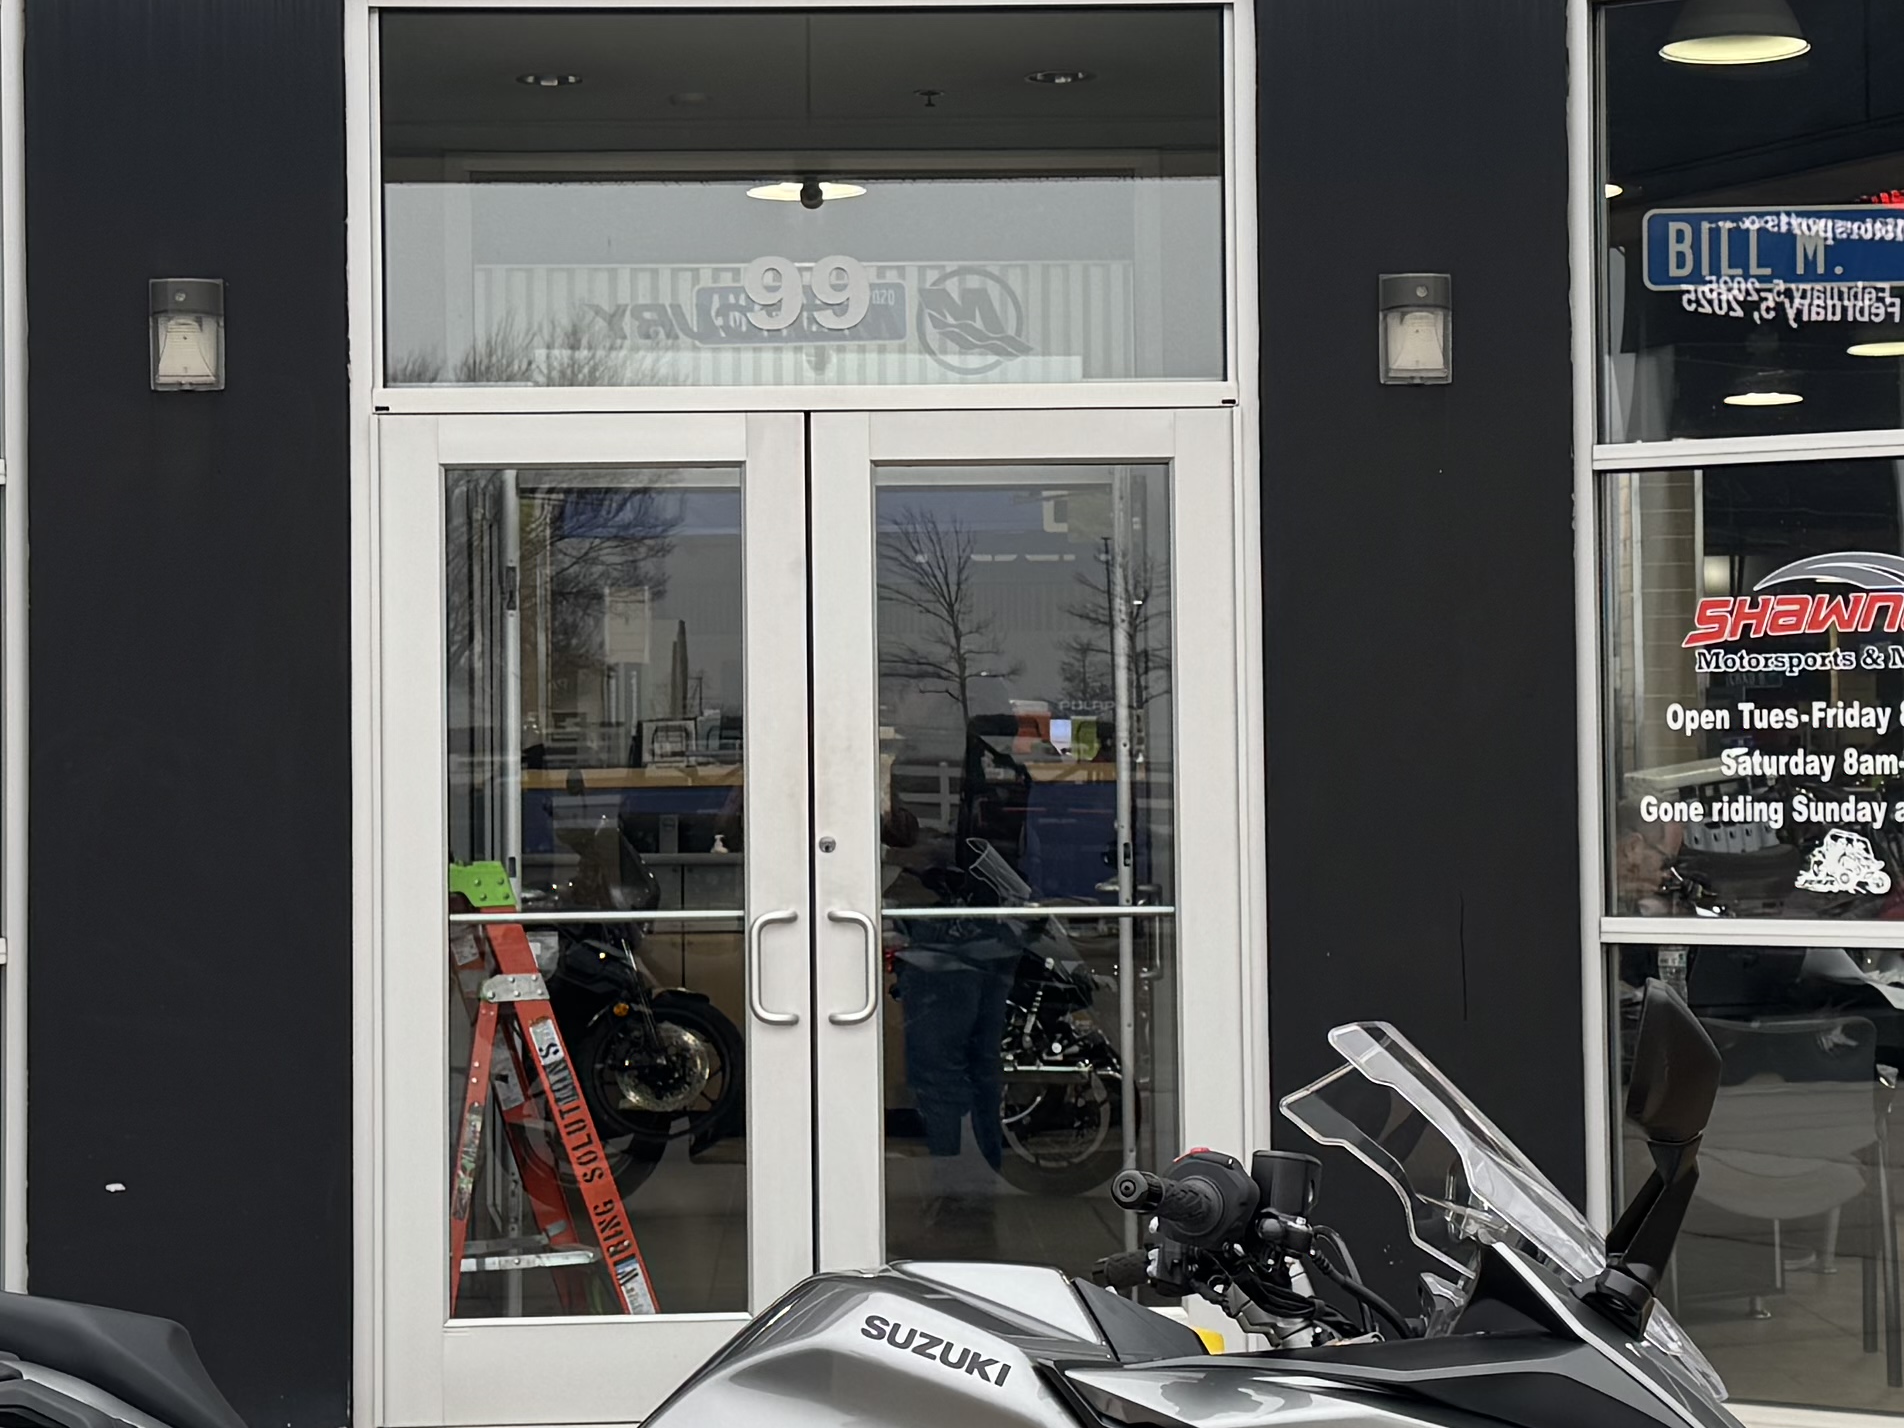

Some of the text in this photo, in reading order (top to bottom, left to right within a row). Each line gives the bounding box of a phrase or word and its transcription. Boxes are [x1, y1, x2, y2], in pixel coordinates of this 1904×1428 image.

[1667, 221, 1772, 277] BILL
[743, 255, 870, 330] 99
[1694, 646, 1856, 676] Motorsports
[1861, 645, 1885, 670] &
[1666, 703, 1730, 736] Open
[1738, 701, 1892, 734] Tues-Friday
[1720, 747, 1836, 783] Saturday
[1640, 795, 1704, 823] Gone
[1712, 795, 1784, 829] riding
[1792, 794, 1887, 830] Sunday
[861, 1315, 1011, 1387] SUZUKI
